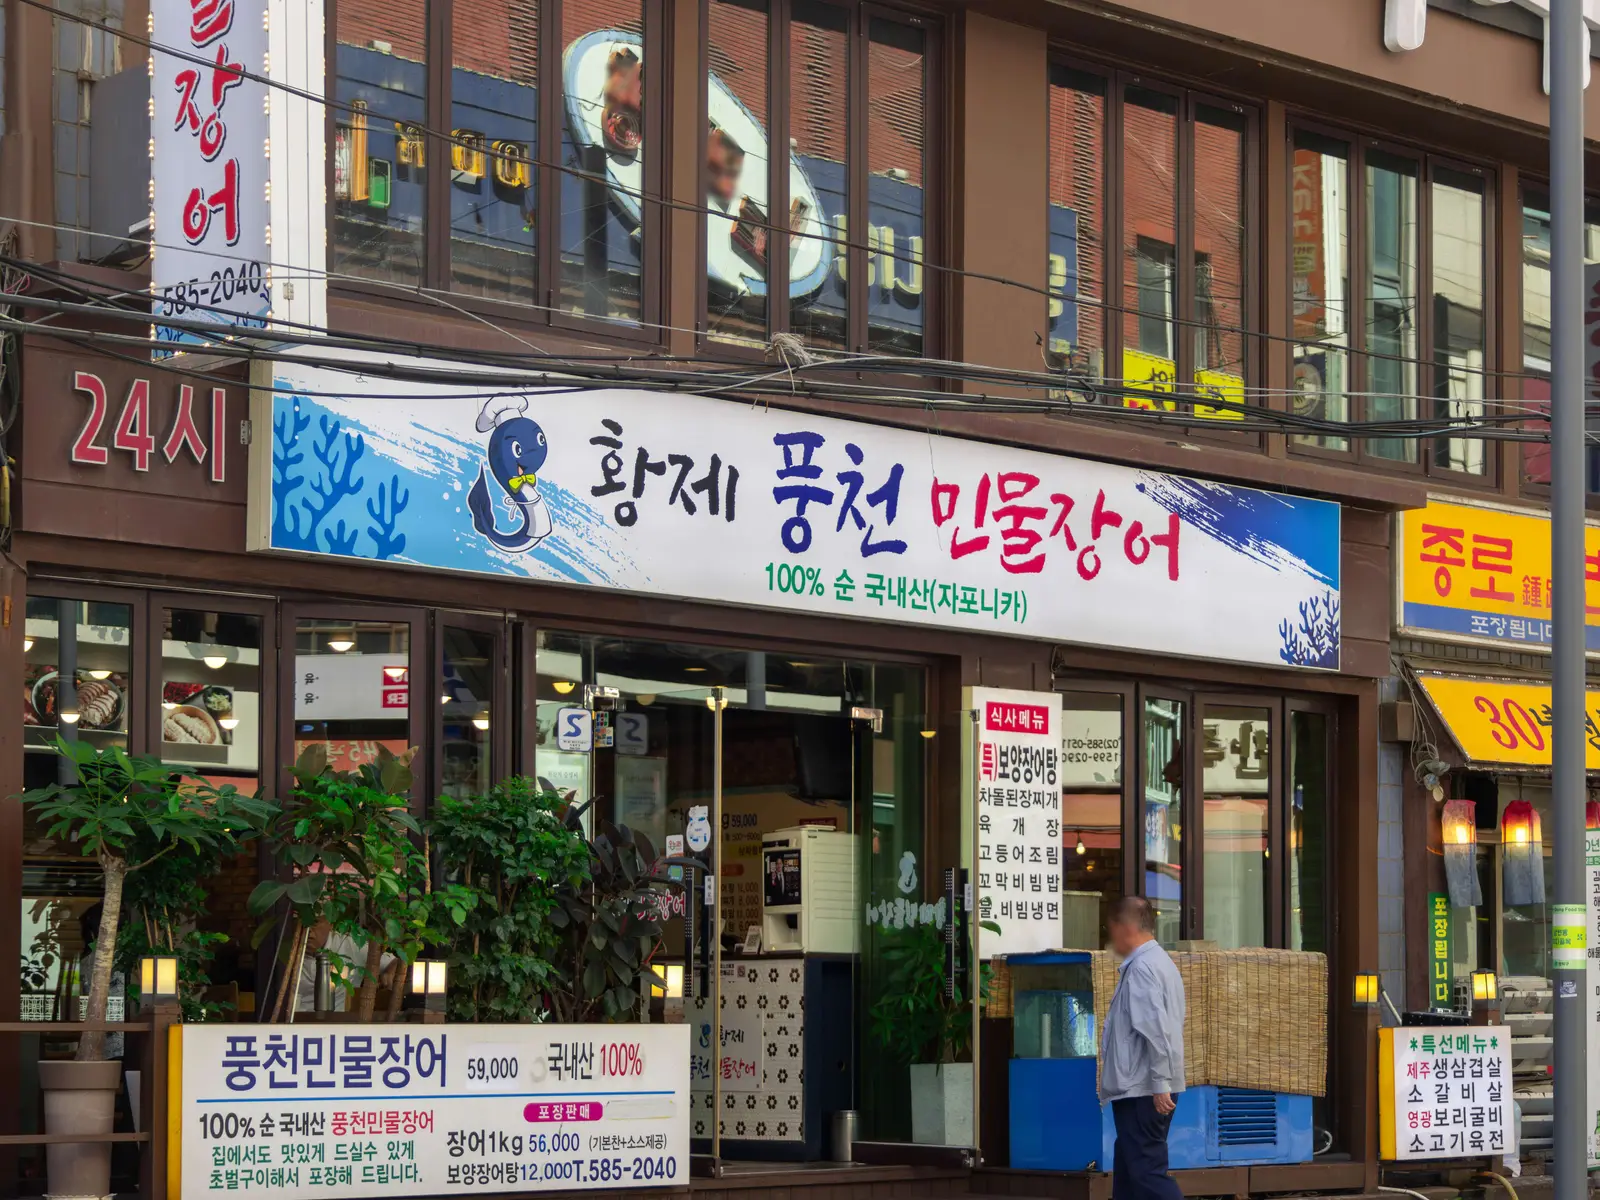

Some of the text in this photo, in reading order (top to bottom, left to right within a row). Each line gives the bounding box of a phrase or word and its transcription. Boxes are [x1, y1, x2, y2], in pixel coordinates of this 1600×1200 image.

[163, 261, 262, 317] 585-2040
[72, 371, 226, 483] 24시
[590, 418, 1181, 581] 황제 풍천 민물장어
[1420, 523, 1515, 603] 종로
[765, 562, 1028, 624] 100% 순 국내산(자포니카)
[990, 706, 1044, 730] 식사메뉴
[980, 787, 1058, 810] 차돌된장찌개
[979, 844, 1058, 865] 고등어조림
[979, 872, 1059, 893] 꼬막비빔밥
[1434, 897, 1448, 1003] 포장됩니다
[1421, 1033, 1488, 1055] 특선메뉴
[222, 1033, 642, 1091] 풍천민물장어 59,000 국내산 100%
[720, 1056, 756, 1080] 물장어
[199, 1109, 434, 1139] 100% 순 국내산 풍천민물장어
[538, 1103, 590, 1120] 포장판매
[212, 1139, 414, 1166] 집에서도 맛있게 드실수 있게
[529, 1133, 580, 1156] 56,000
[588, 1133, 668, 1152] (기본찬+소스제공)
[1409, 1130, 1504, 1153] 소고기육전
[209, 1162, 423, 1190] 초벌구이해서 포장해 드립니다.
[446, 1161, 519, 1185] 보양장어탕
[572, 1156, 677, 1183] T.585-2040
